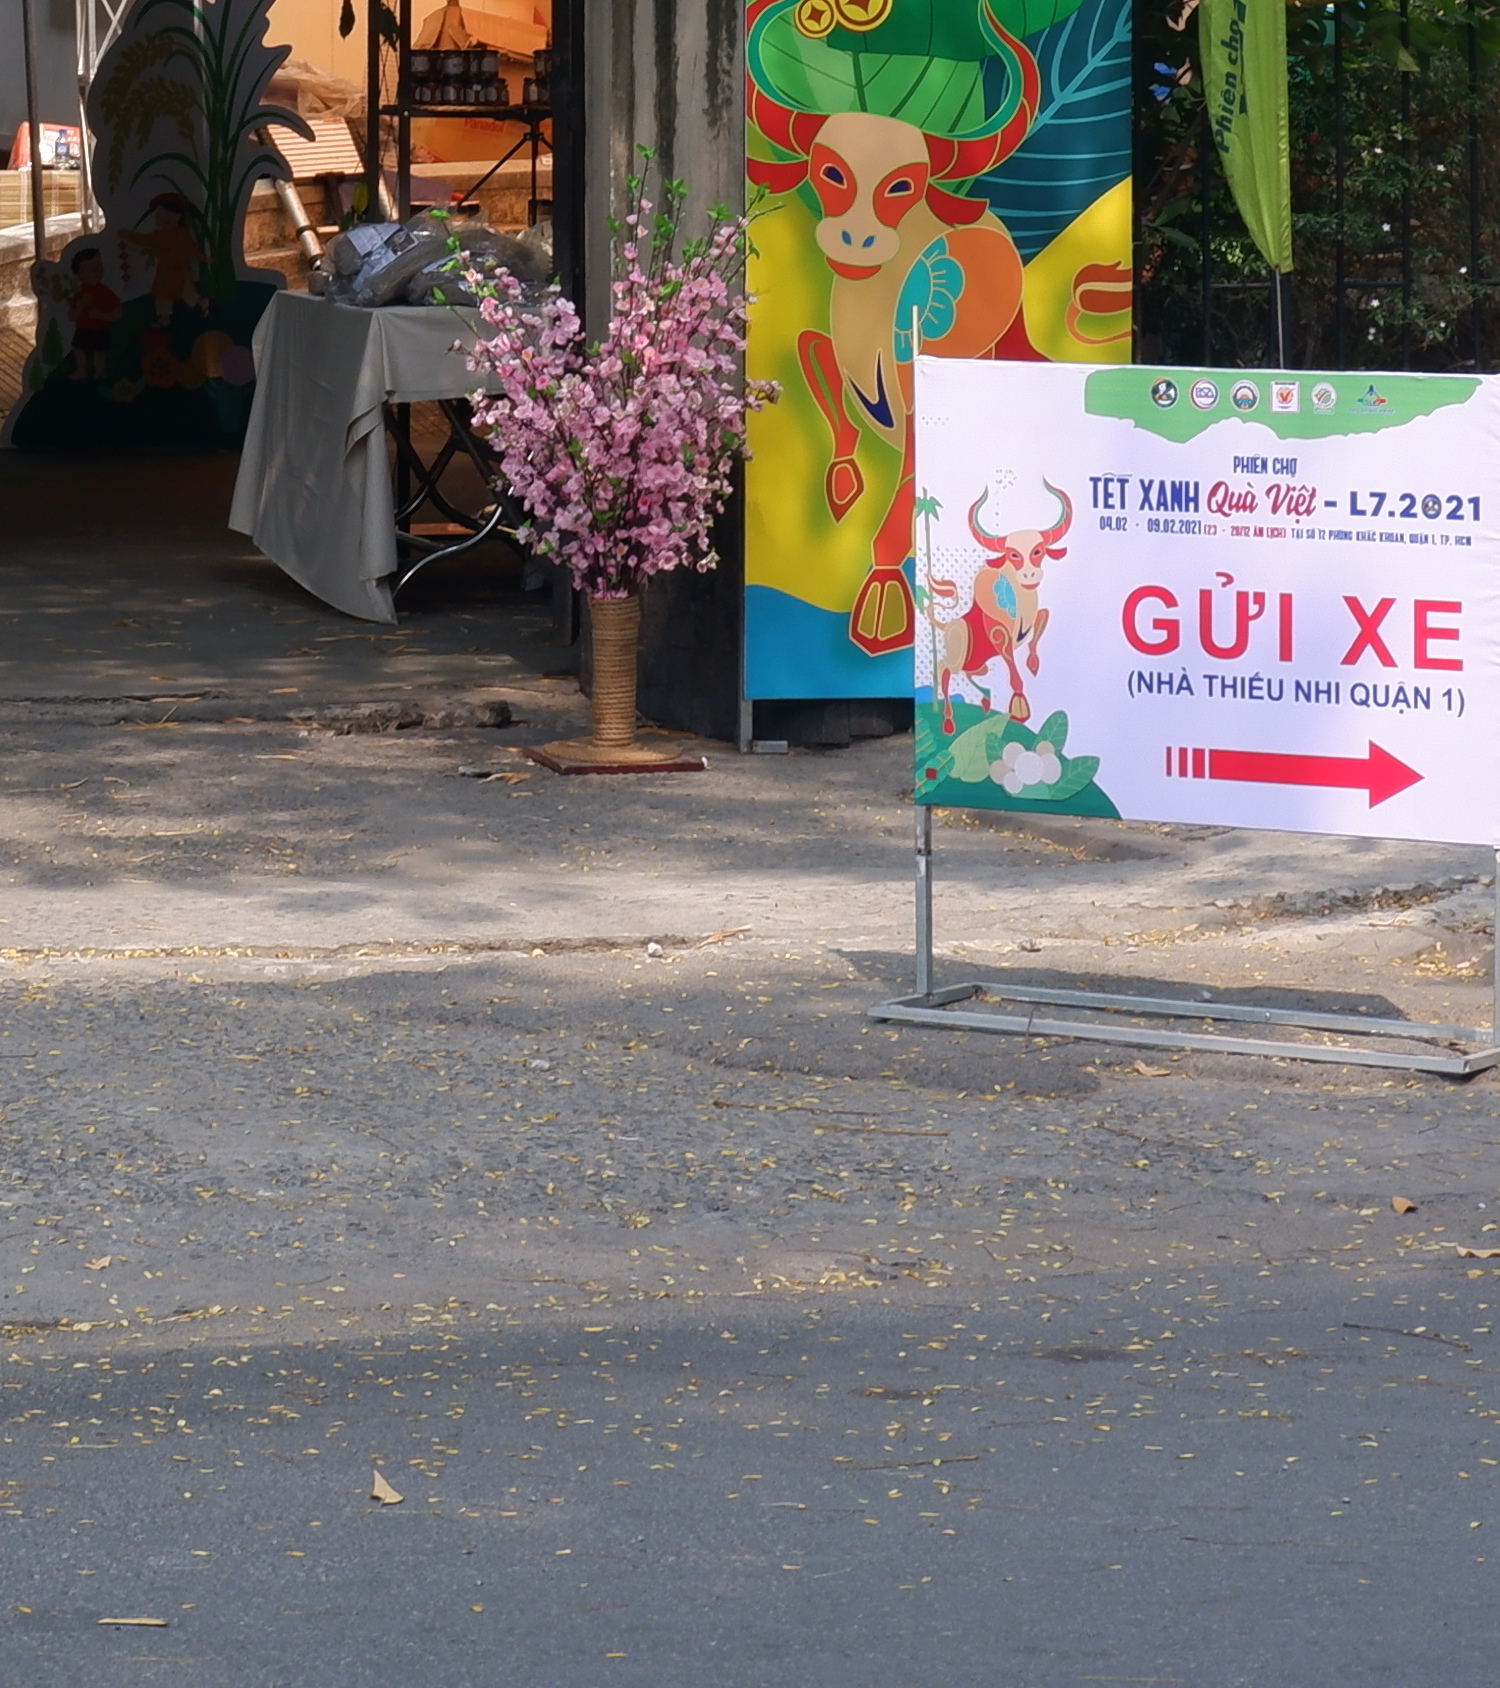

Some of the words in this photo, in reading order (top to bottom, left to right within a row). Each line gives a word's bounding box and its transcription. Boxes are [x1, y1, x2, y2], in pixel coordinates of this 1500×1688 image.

[1233, 454, 1268, 474] PHIÊN
[1272, 457, 1298, 478] CHỢ
[1089, 472, 1133, 510] TẾT
[1138, 477, 1200, 513] XANH
[1206, 480, 1259, 518] Quà
[1264, 483, 1317, 524] Việt
[1099, 515, 1128, 532] 04.02
[1147, 517, 1202, 535] 09.02.2021
[1121, 572, 1294, 663] GỬI
[1341, 595, 1464, 671] XE
[1127, 666, 1194, 700] (NHÀ
[1204, 670, 1285, 702] THIẾU
[1294, 678, 1341, 705] NHI
[1349, 679, 1432, 716] QUẬN
[1441, 686, 1467, 718] 1)
